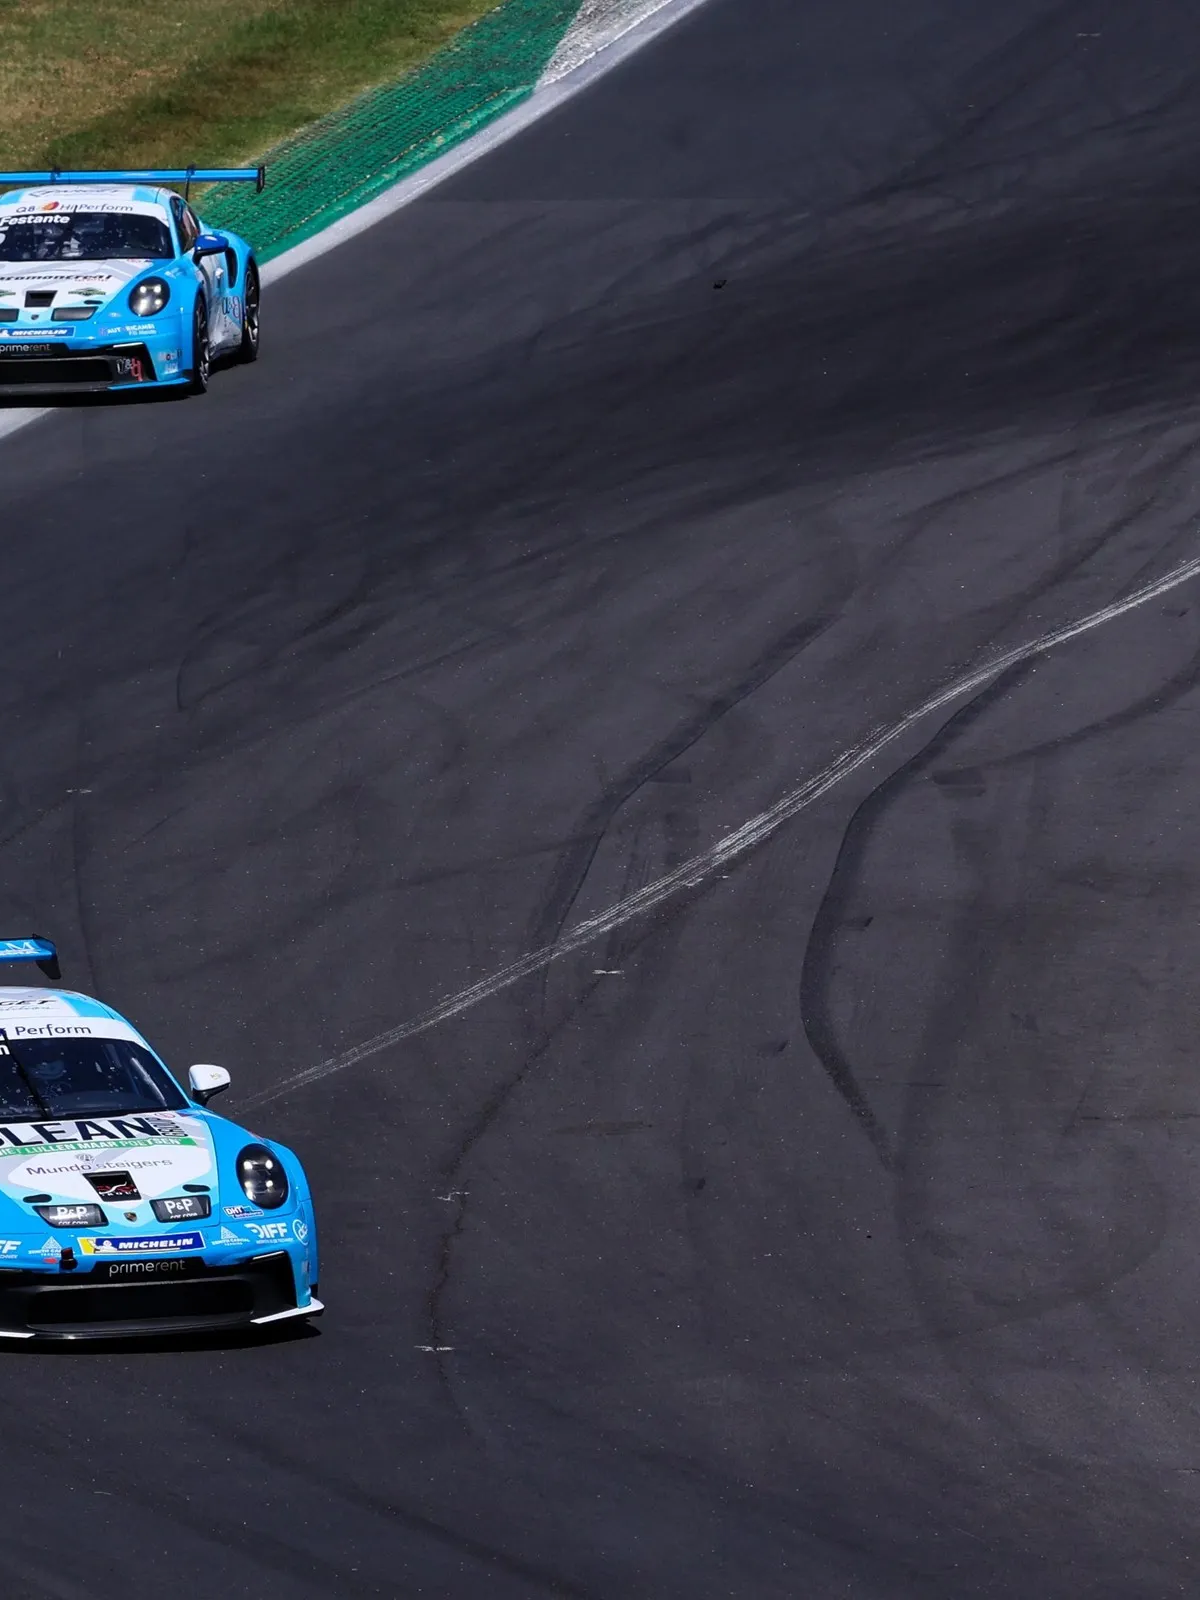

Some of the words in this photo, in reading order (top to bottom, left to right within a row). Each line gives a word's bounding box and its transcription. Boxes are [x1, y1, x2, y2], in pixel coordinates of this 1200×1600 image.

[15, 205, 35, 213] Q8
[79, 203, 134, 212] Perform
[0, 215, 71, 226] Festante
[11, 329, 68, 337] MICHELIN
[15, 1024, 92, 1036] Perform
[27, 1143, 74, 1155] LULLEN
[79, 1140, 118, 1151] MAAR
[26, 1161, 92, 1176] Mundo
[97, 1158, 173, 1171] steigers
[57, 1206, 87, 1219] P&P
[164, 1198, 194, 1214] P&P
[244, 1222, 288, 1239] DIFF
[118, 1238, 194, 1249] MICHELIN
[109, 1259, 186, 1278] primerent
